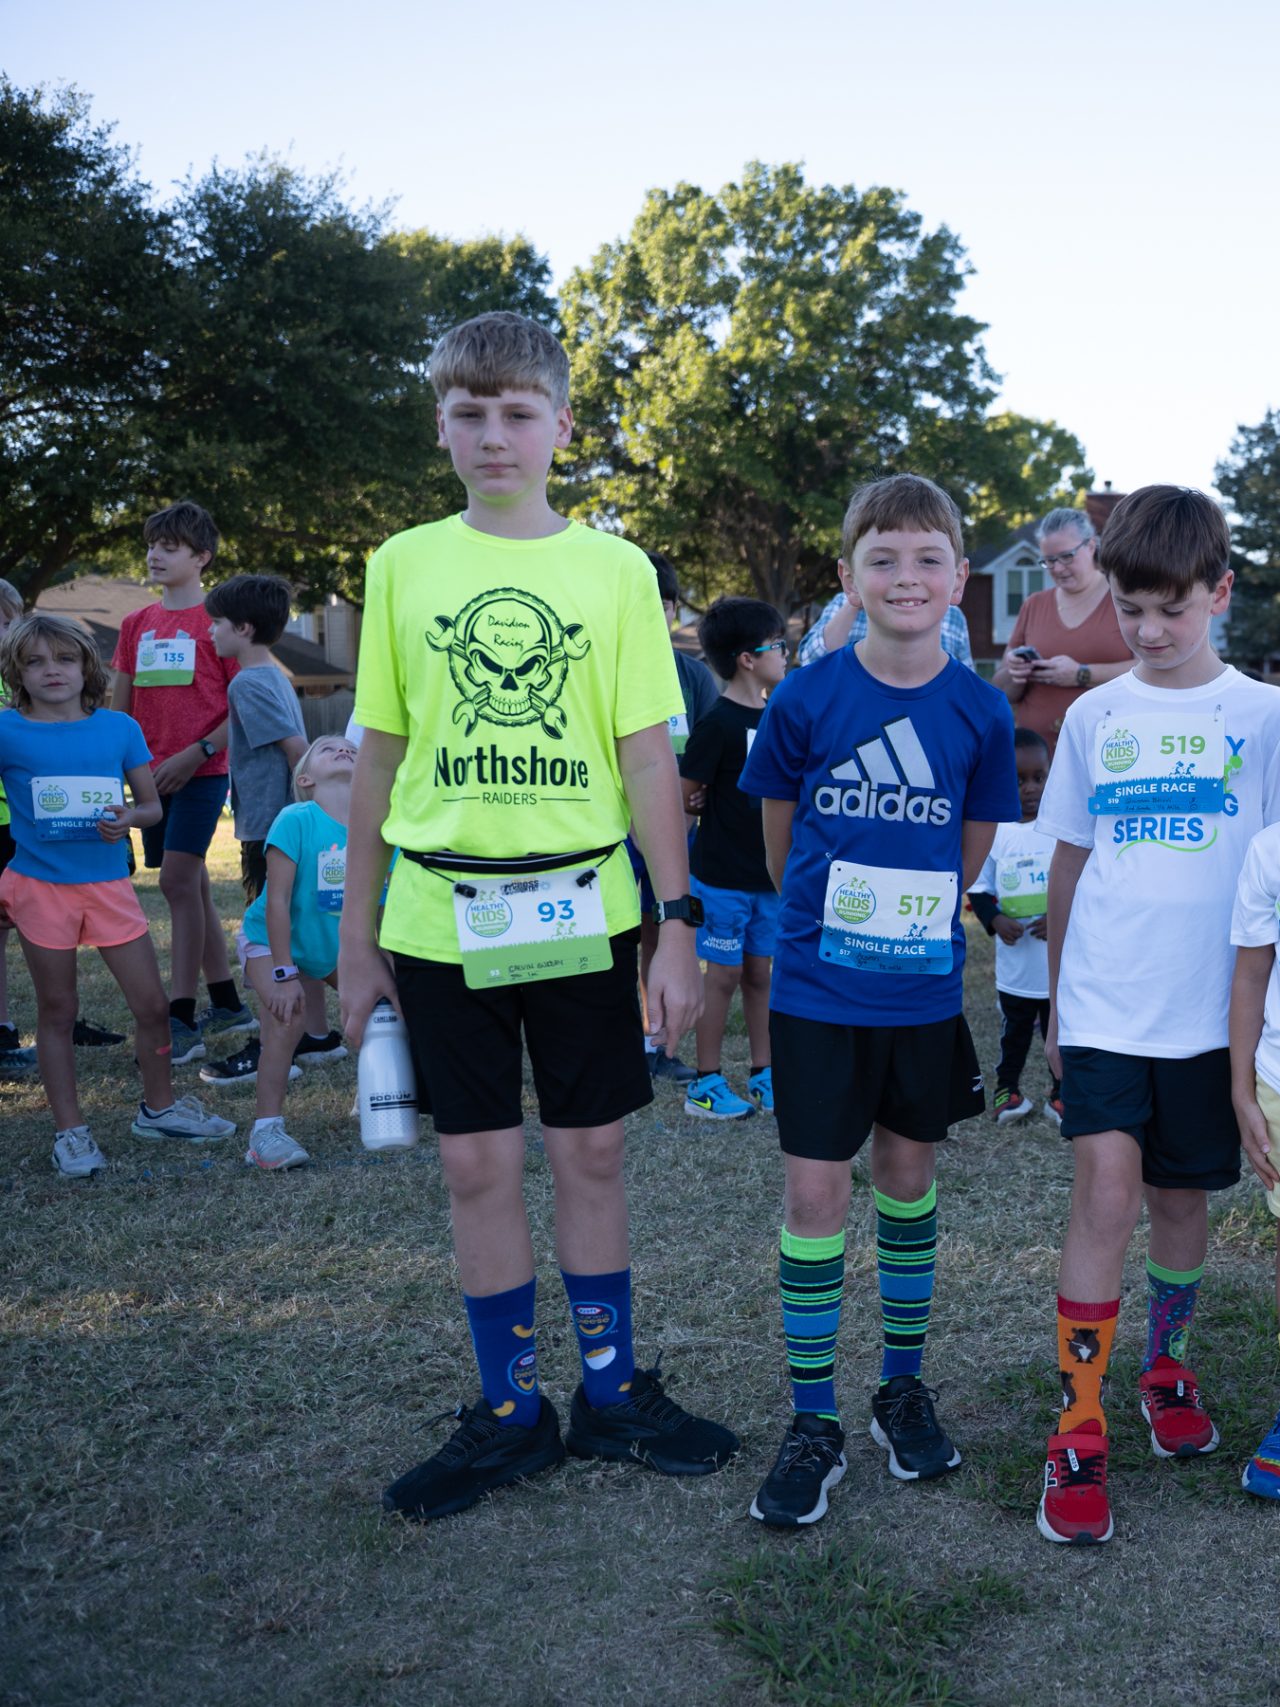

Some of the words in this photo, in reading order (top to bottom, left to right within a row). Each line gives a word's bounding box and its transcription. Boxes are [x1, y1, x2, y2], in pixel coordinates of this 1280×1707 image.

[487, 614, 530, 628] Davidson
[493, 633, 524, 650] Racing
[163, 652, 185, 663] 135
[1105, 740, 1134, 749] HEALTHY
[1159, 735, 1206, 755] 519
[1105, 746, 1134, 760] KIDS
[434, 744, 589, 789] Northshore
[1115, 783, 1158, 798] SINGLE
[1161, 782, 1197, 793] RACE
[41, 796, 65, 804] KIDS
[81, 791, 113, 804] 522
[482, 792, 538, 805] RAIDERS
[815, 780, 952, 826] adidas
[1113, 816, 1204, 844] SERIES
[1029, 871, 1049, 884] 14
[839, 889, 871, 899] HEALTHY
[470, 903, 504, 912] HEALTHY
[837, 895, 870, 910] KIDS
[897, 895, 941, 917] 517
[472, 909, 506, 924] KIDS
[537, 899, 575, 923] 93
[839, 948, 851, 956] 517
[844, 937, 891, 954] SINGLE
[894, 945, 927, 955] RACE
[370, 1093, 412, 1102] PODIUM
